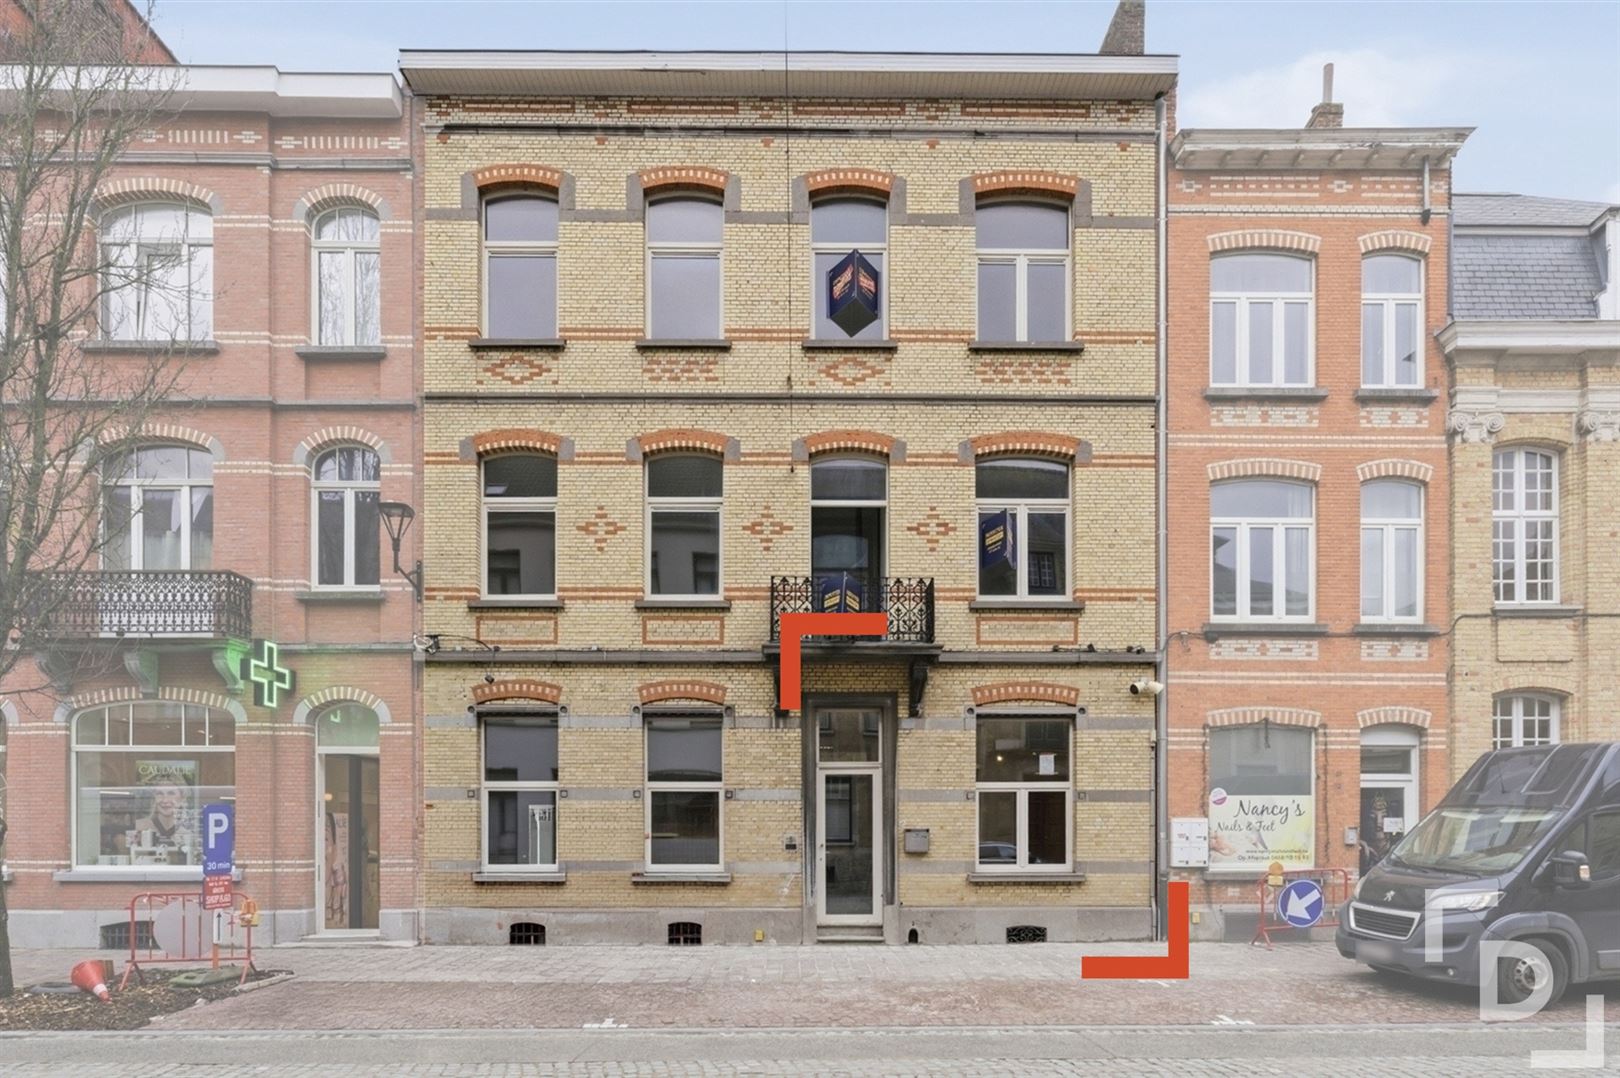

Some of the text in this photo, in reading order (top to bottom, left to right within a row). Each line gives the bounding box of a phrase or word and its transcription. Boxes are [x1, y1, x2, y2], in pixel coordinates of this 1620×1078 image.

[1233, 799, 1305, 824] Nancy's
[208, 812, 229, 849] P
[1215, 820, 1275, 832] Nails & Feet
[207, 861, 230, 870] 30 min
